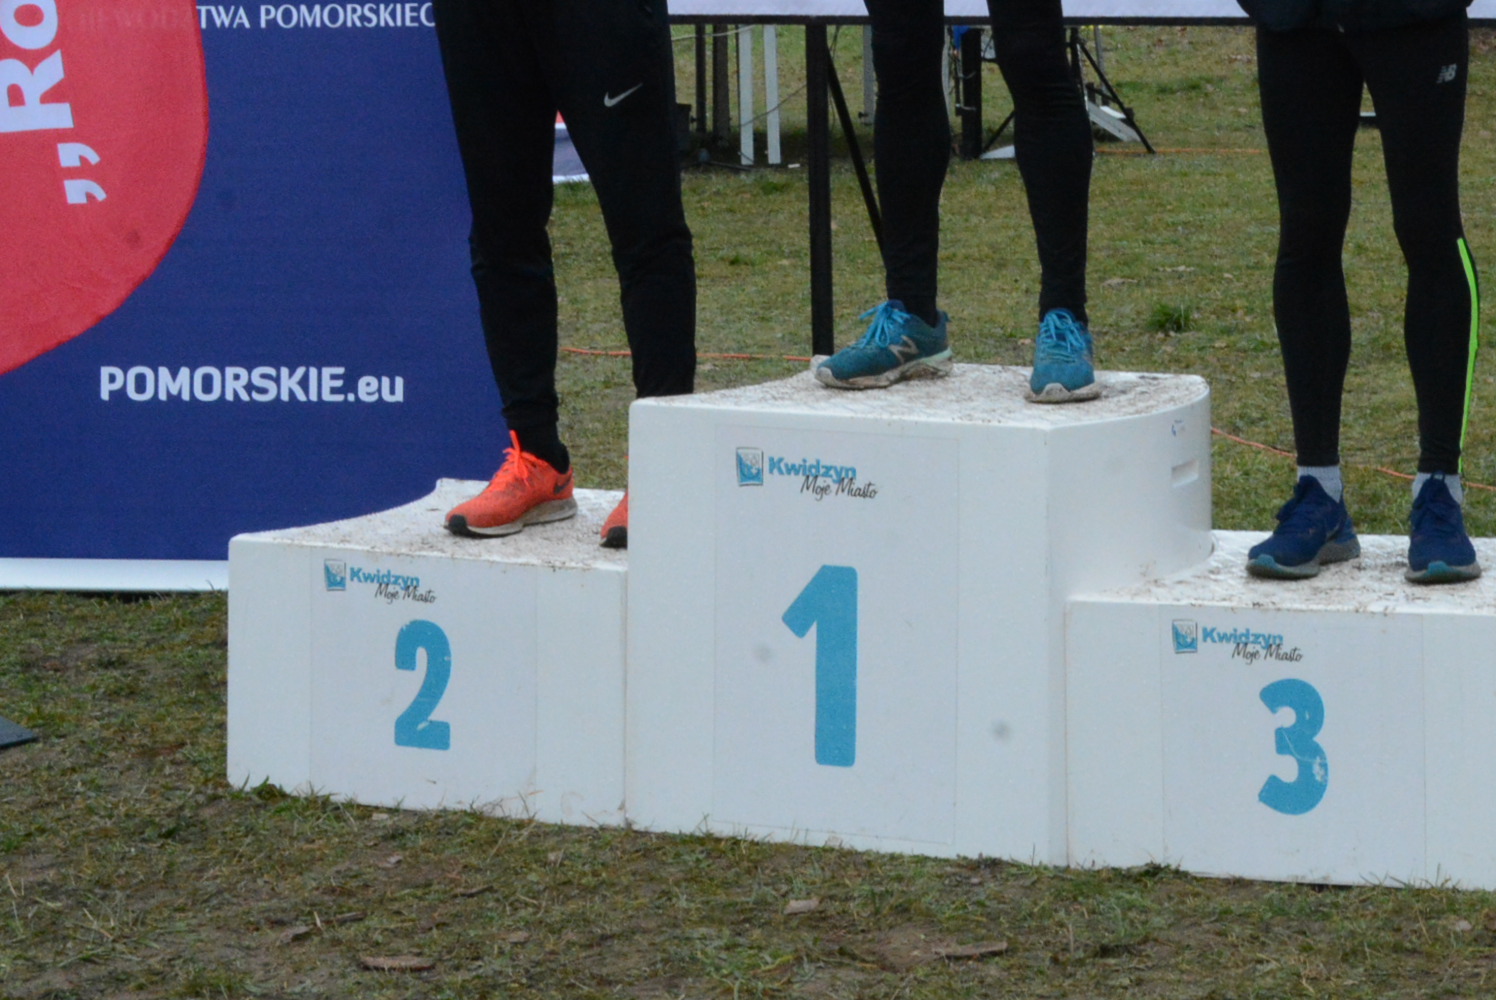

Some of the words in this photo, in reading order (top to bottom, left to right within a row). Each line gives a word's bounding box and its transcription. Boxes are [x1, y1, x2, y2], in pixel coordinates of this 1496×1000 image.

[100, 365, 405, 403] POMORSKIE.eu
[768, 455, 857, 484] Kwidzyn
[349, 566, 421, 591] Kwidzyn
[1201, 626, 1284, 650] Kwidzyn
[394, 618, 453, 751] 2
[781, 563, 859, 768] 1
[1257, 677, 1330, 816] 3
